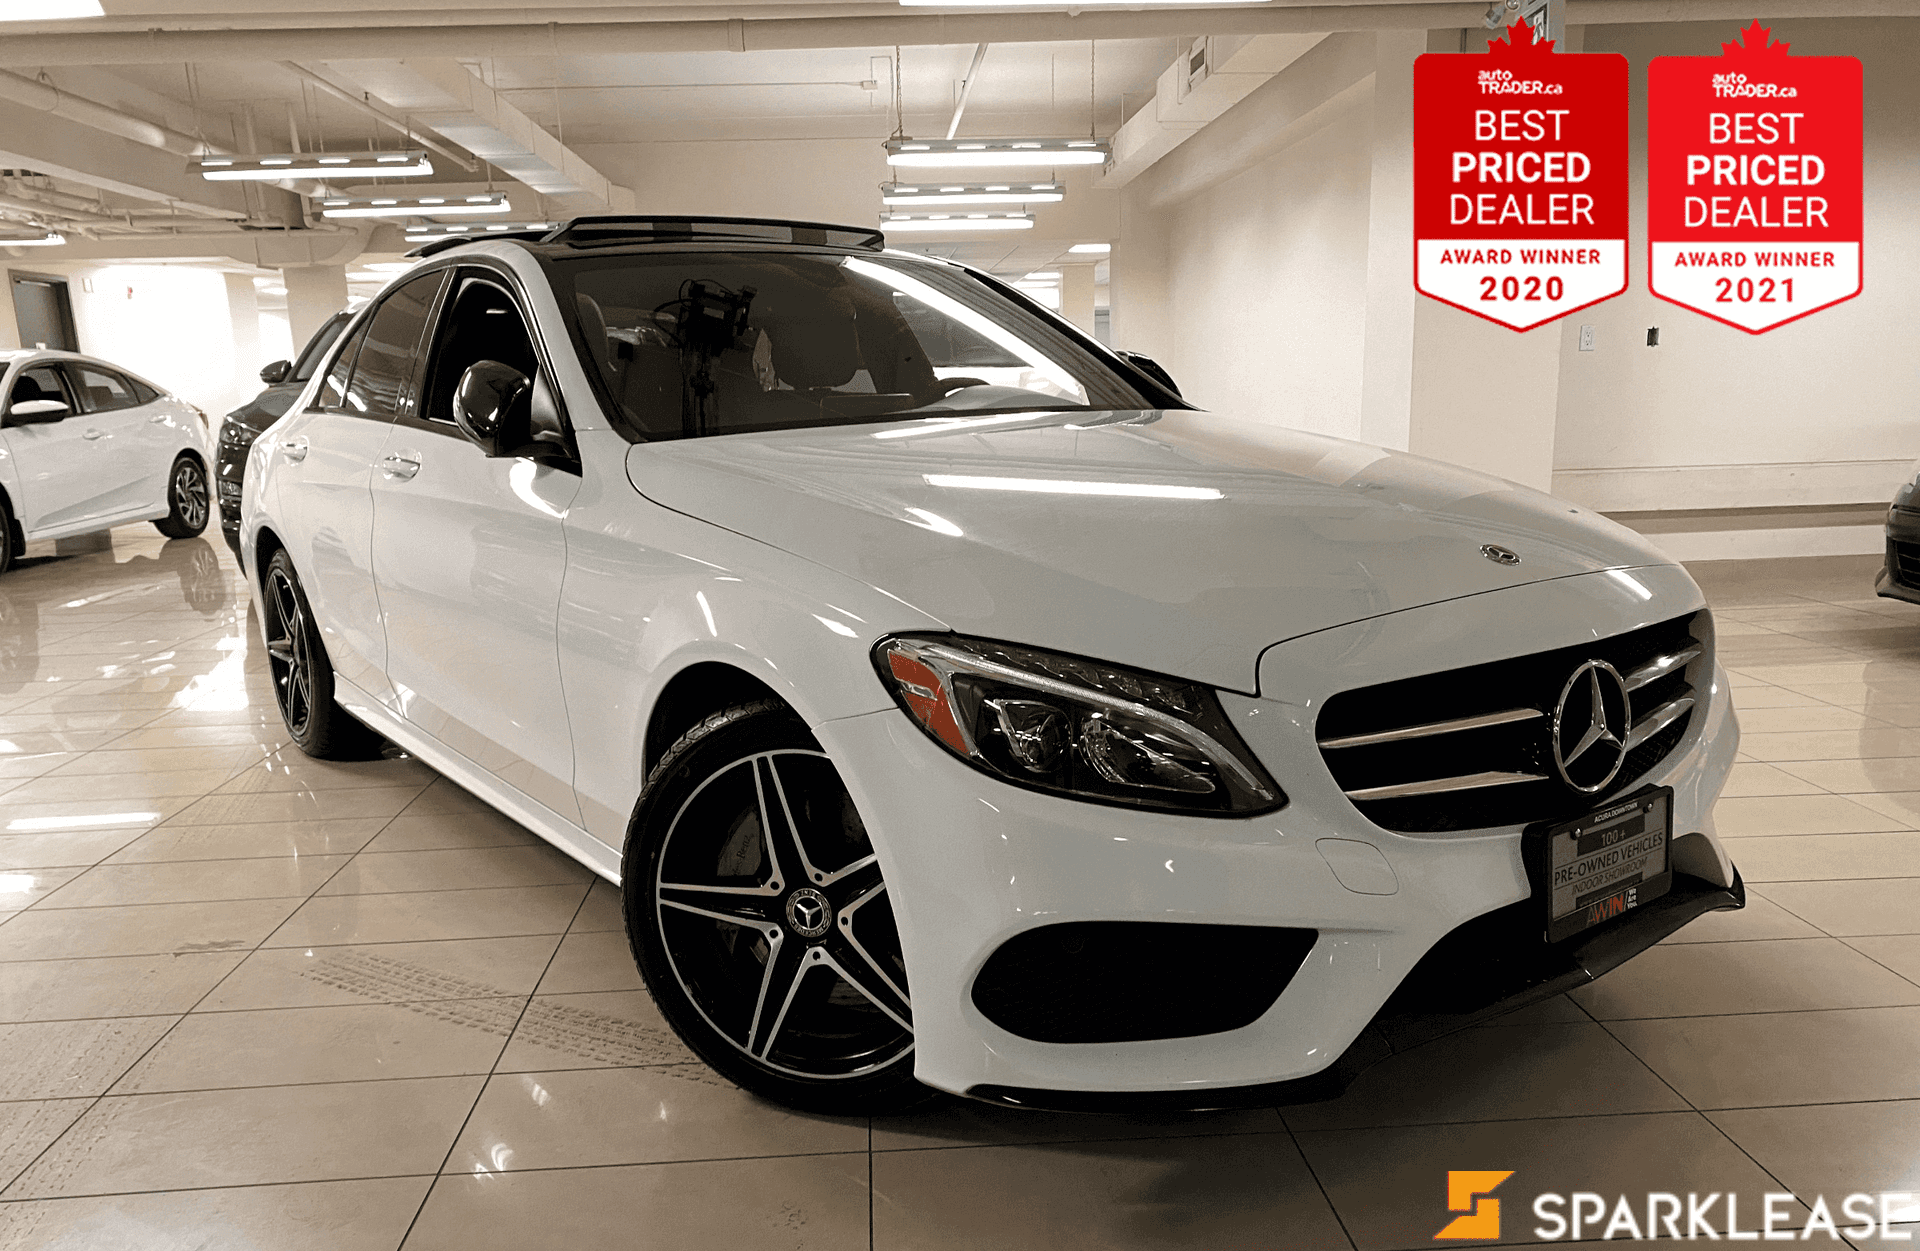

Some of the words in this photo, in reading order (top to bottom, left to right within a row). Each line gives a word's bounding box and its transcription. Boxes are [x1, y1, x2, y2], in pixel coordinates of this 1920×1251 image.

[1594, 811, 1612, 823] ACURA
[1611, 802, 1638, 817] DOWNTOWN
[1554, 850, 1619, 885] PRE-OWNED
[1620, 831, 1663, 860] VEHICLES
[1572, 874, 1604, 896] INDOOR
[1604, 857, 1648, 884] SHOWROOM
